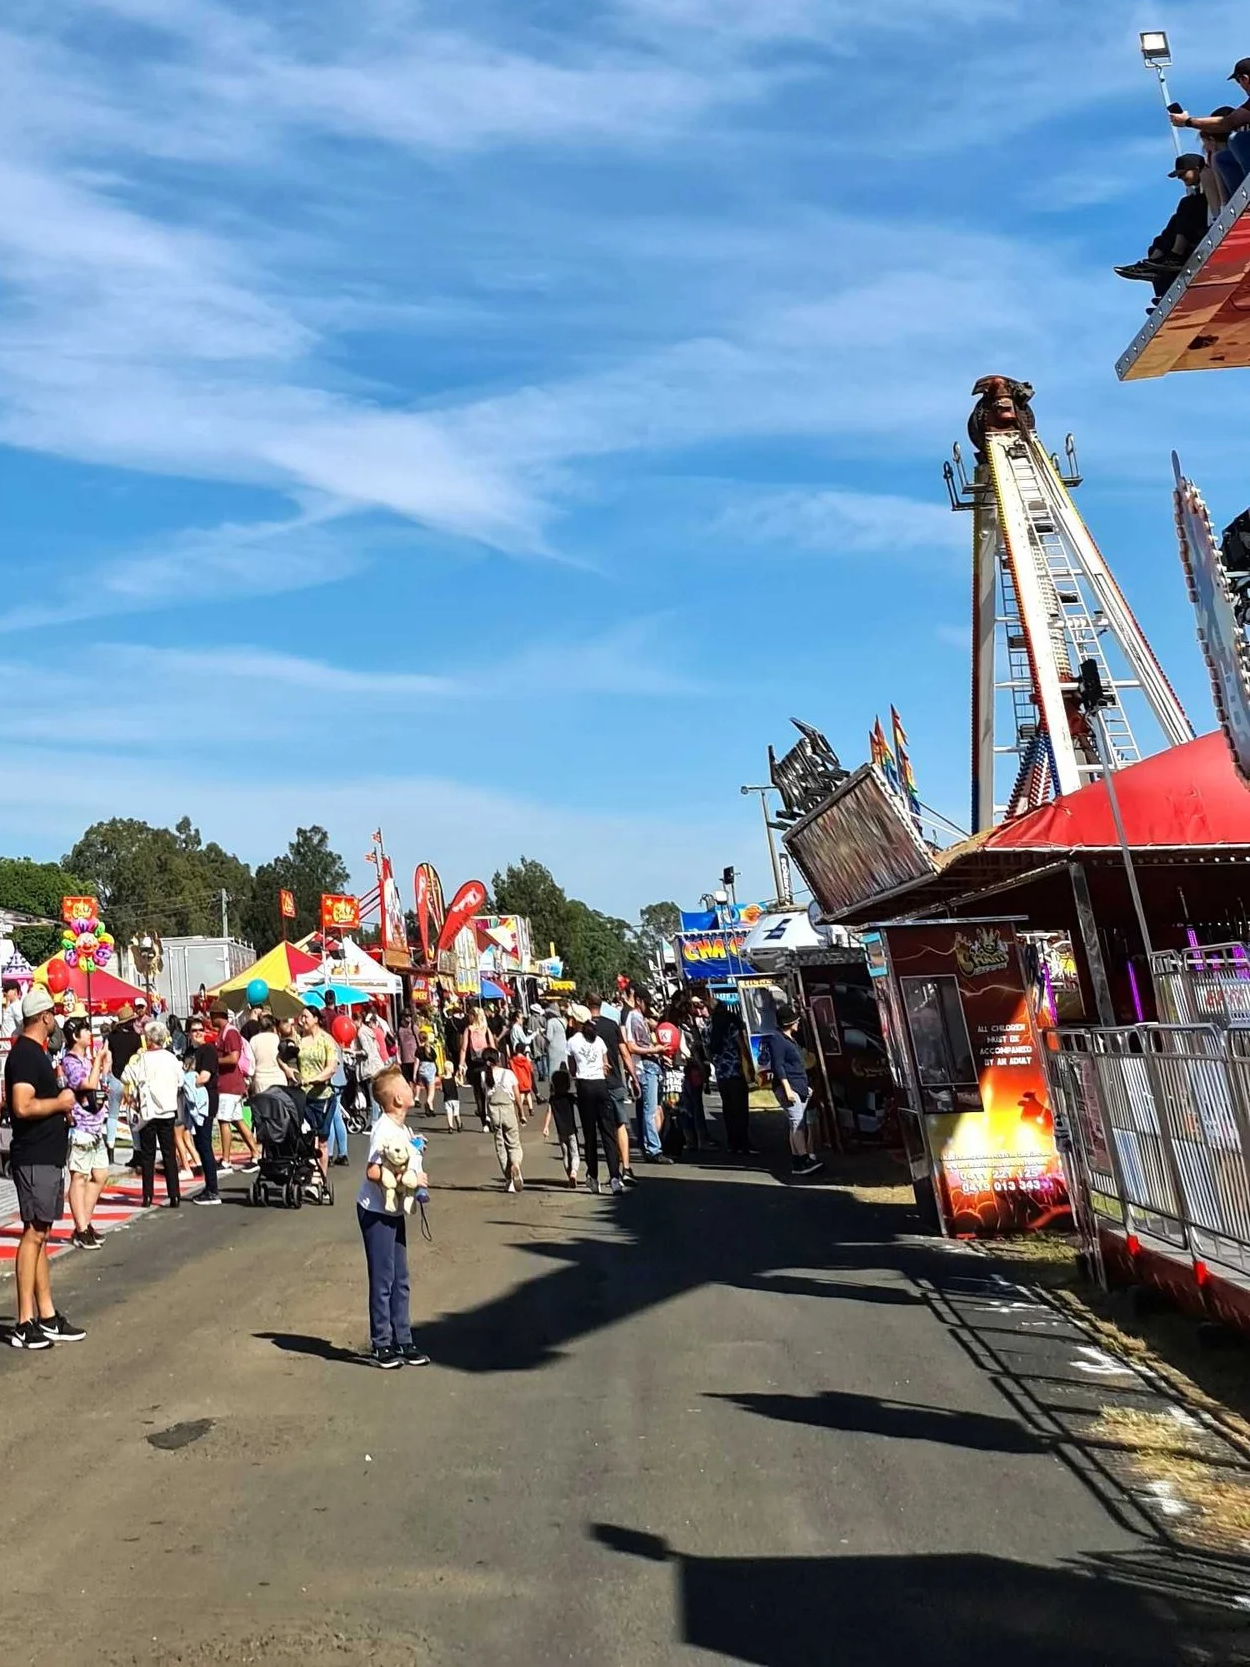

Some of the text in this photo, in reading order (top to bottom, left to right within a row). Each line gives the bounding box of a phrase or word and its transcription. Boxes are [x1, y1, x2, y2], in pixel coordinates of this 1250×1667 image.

[683, 938, 727, 962] CHA
[977, 1023, 1026, 1033] ALL CHILDREN
[987, 1035, 1020, 1043] MUST BE
[980, 1046, 1033, 1055] ACCOMPANIED
[997, 1057, 1007, 1066] AN
[1009, 1057, 1032, 1065] ADULT
[994, 1181, 1016, 1191] 013
[1019, 1180, 1041, 1190] 343
